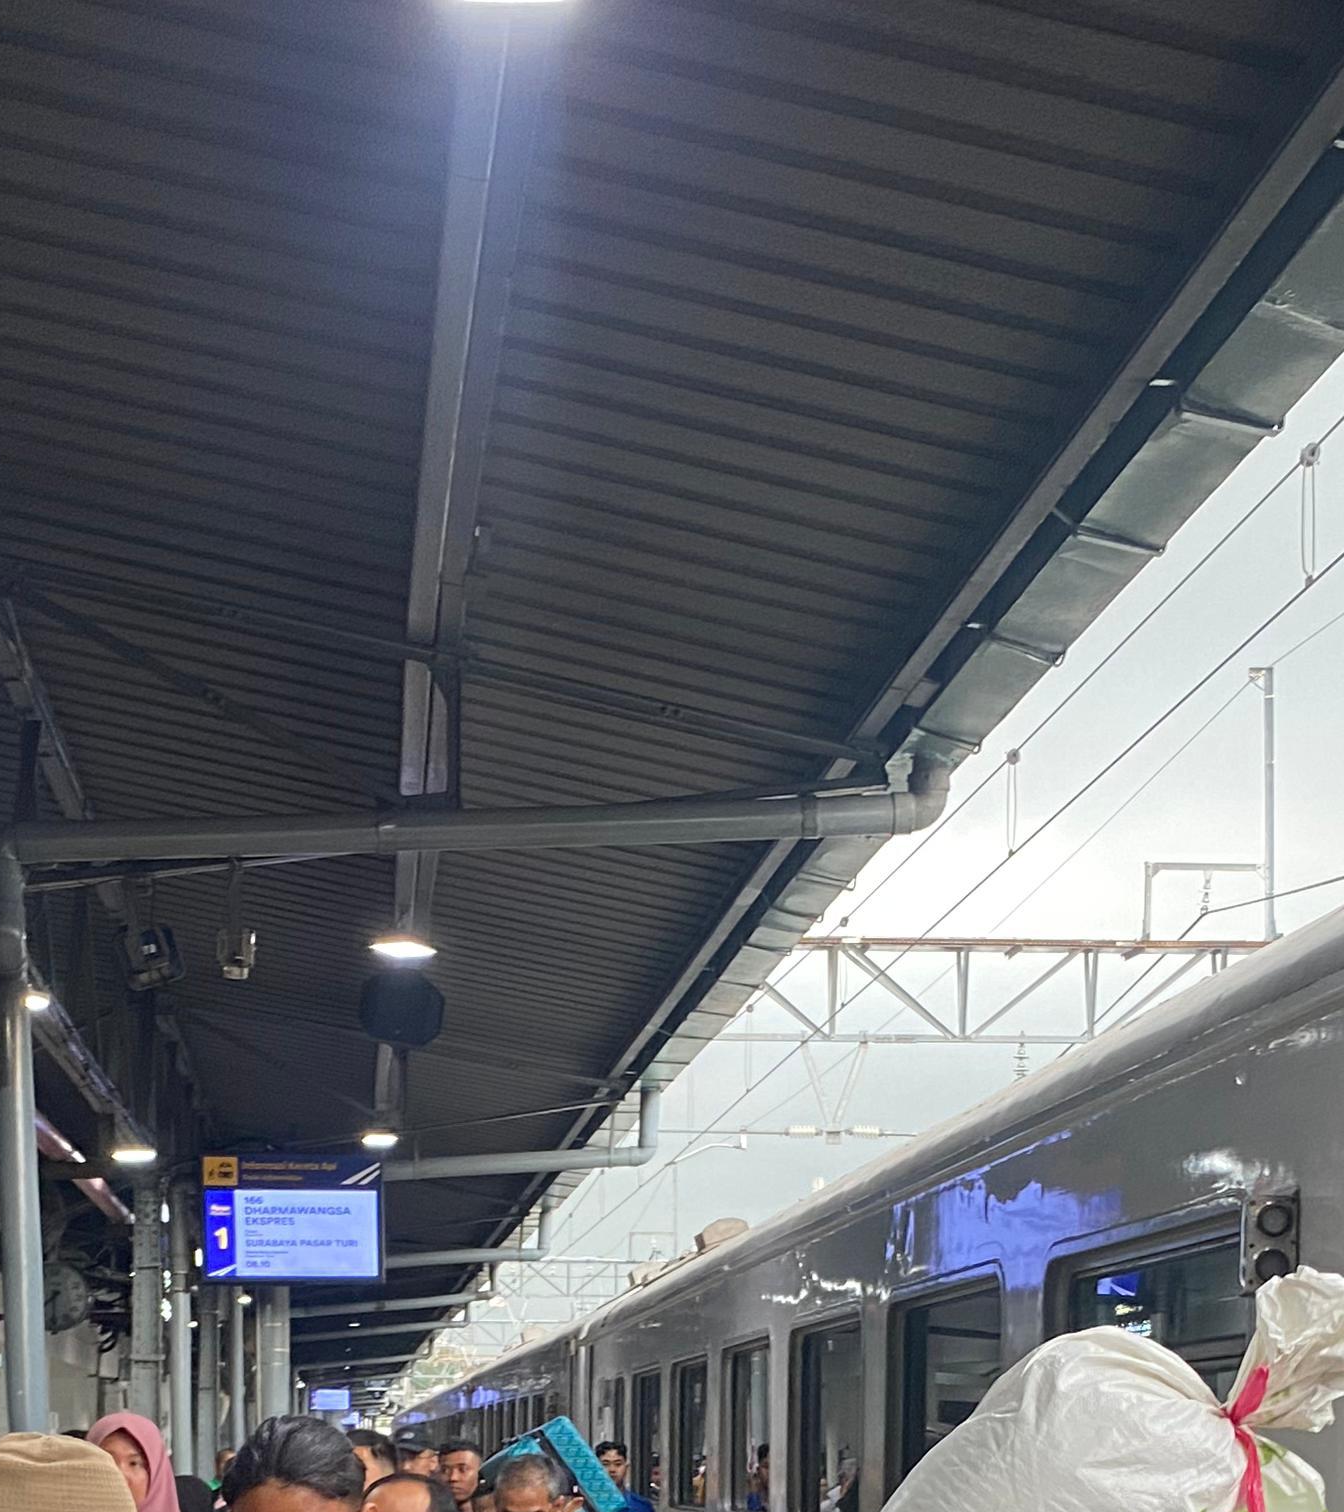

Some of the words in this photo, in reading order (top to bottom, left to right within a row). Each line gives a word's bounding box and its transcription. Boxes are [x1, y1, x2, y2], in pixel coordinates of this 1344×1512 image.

[244, 1206, 352, 1216] DHARMAWANGSA
[244, 1217, 296, 1226] EKSPRES
[213, 1226, 229, 1250] 1
[245, 1239, 298, 1248] SURABAYA
[334, 1239, 358, 1248] TURI
